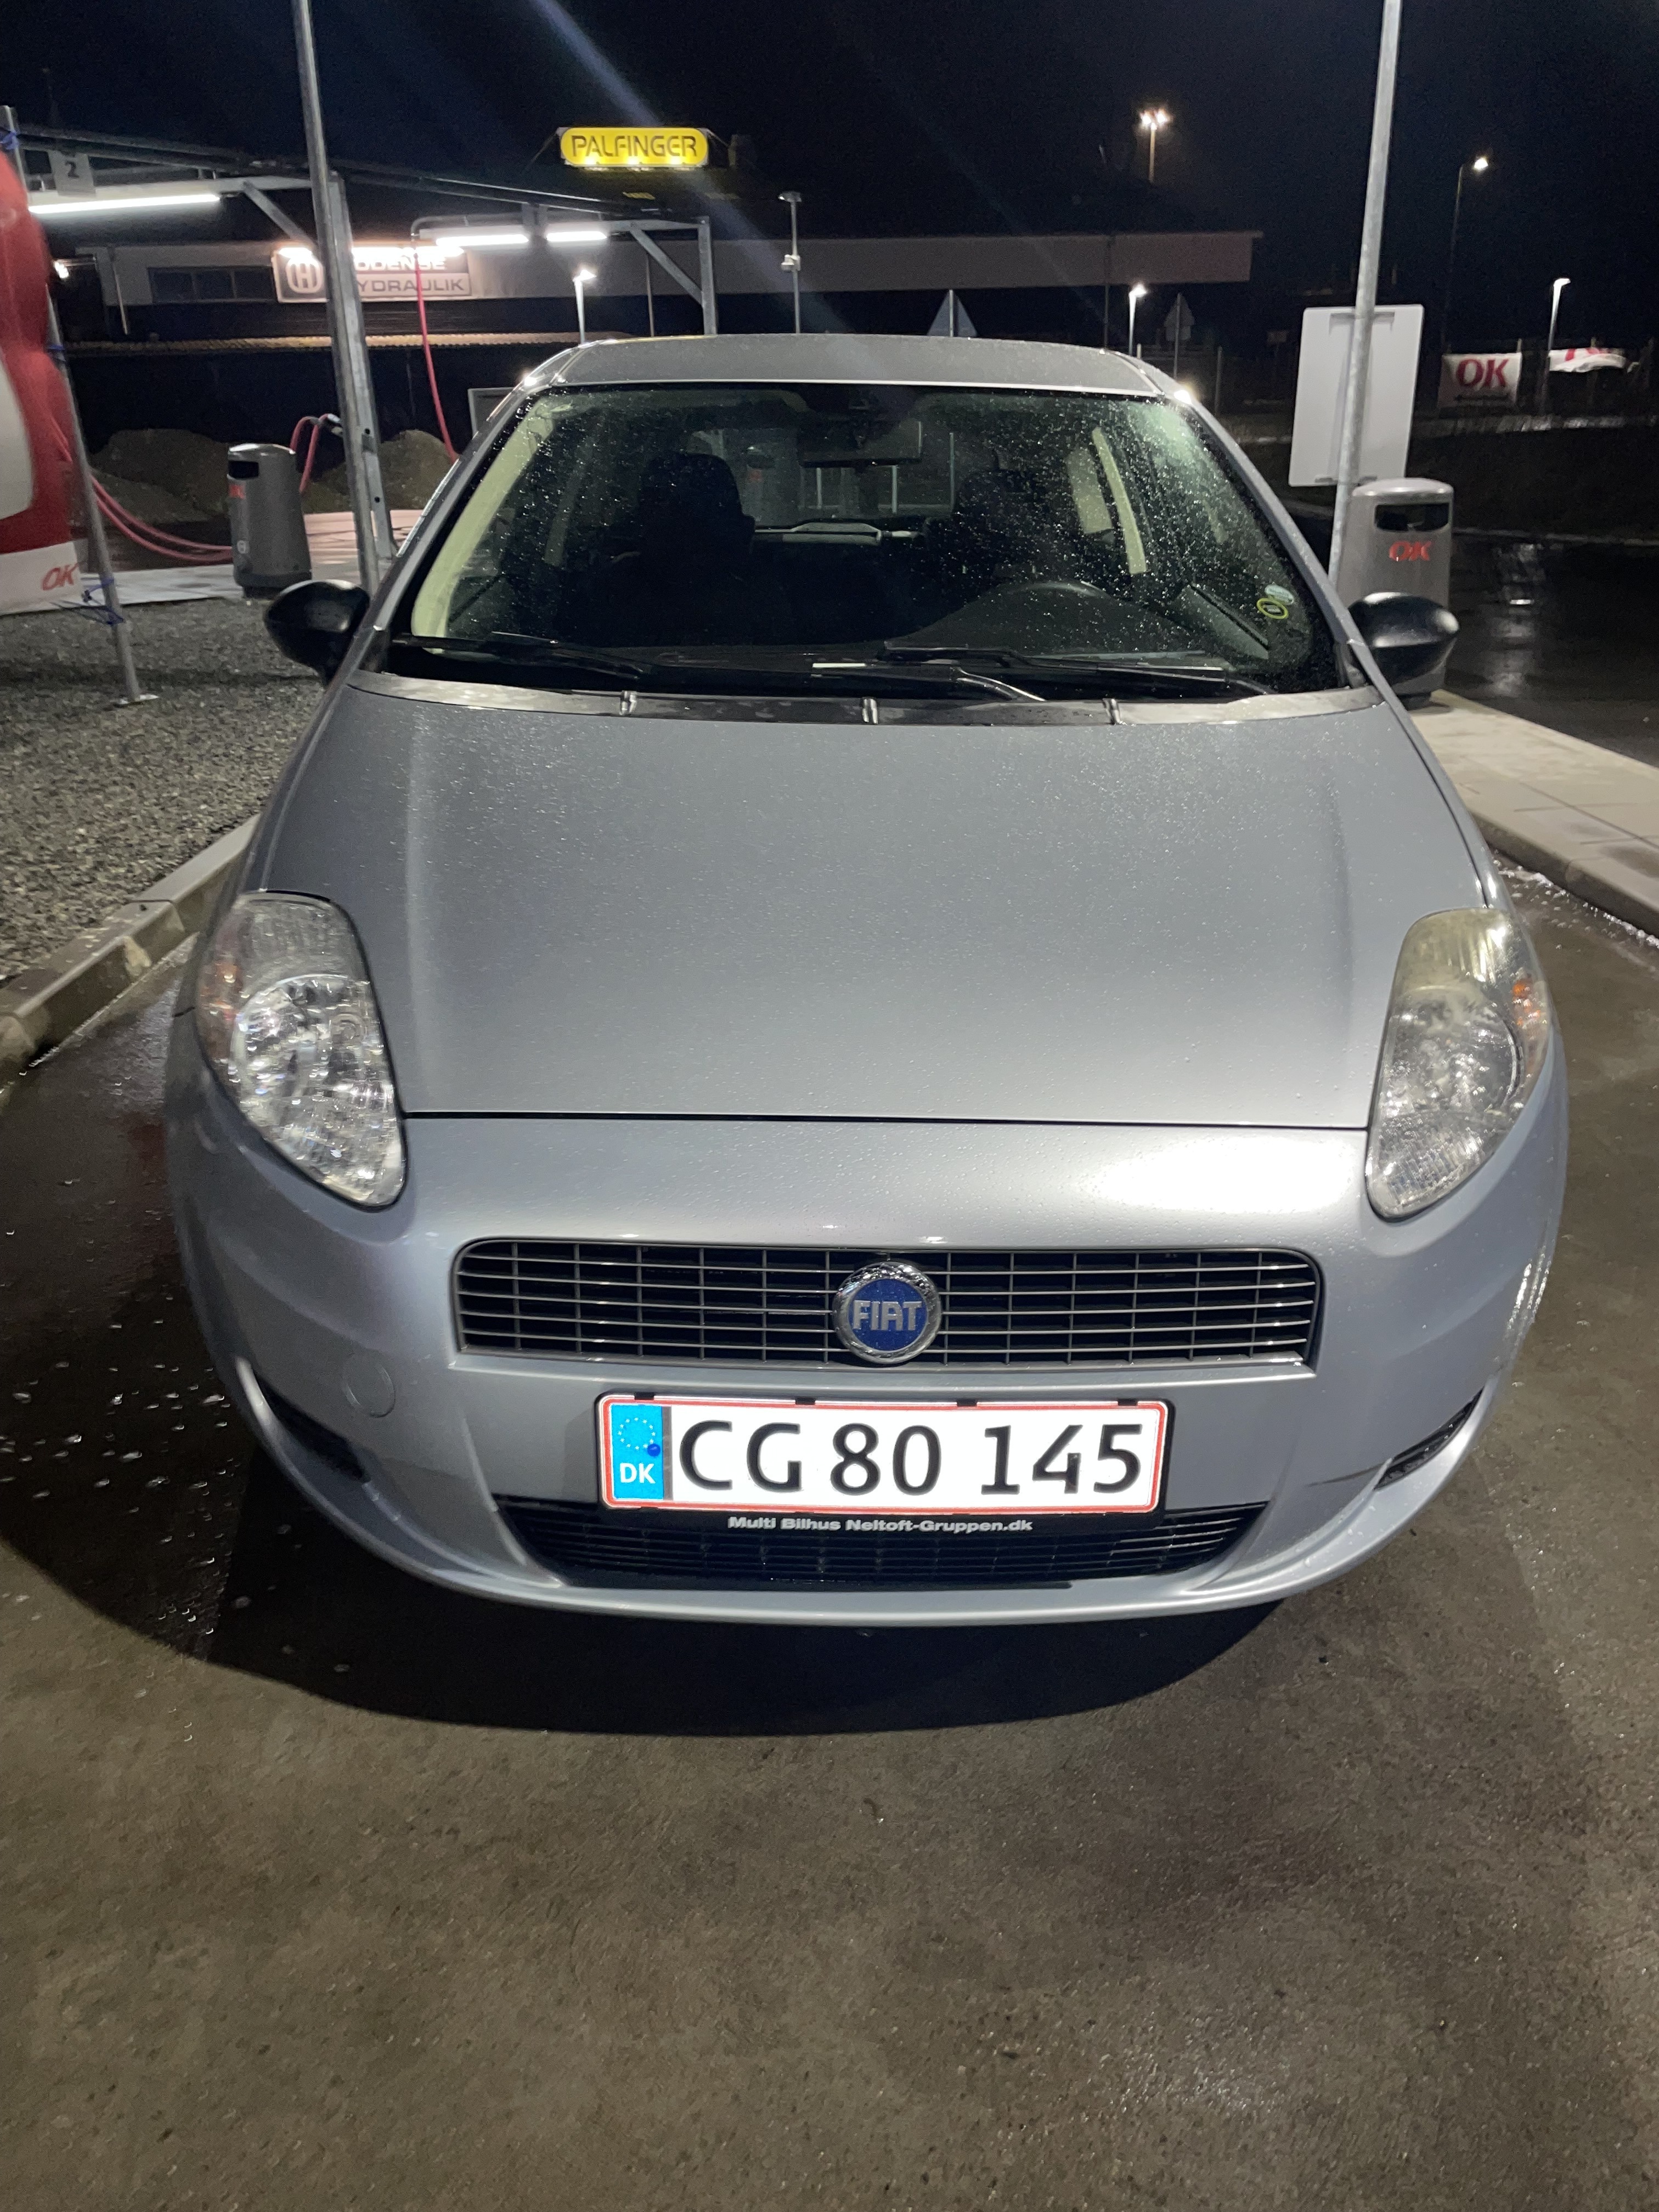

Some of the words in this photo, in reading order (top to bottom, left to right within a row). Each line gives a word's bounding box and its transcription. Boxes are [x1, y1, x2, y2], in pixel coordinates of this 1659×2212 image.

[571, 135, 697, 157] PALFINGER
[65, 160, 80, 178] 2
[357, 279, 465, 292] YDRAULIK
[1455, 359, 1509, 387] OK
[1389, 540, 1431, 562] OK
[42, 563, 79, 591] OK
[853, 1300, 922, 1331] FIAT
[679, 1420, 802, 1492] CG
[830, 1423, 942, 1496] 80
[981, 1424, 1143, 1495] 145
[619, 1463, 656, 1484] DK
[727, 1516, 776, 1529] Multi
[780, 1518, 841, 1531] Bilhus
[845, 1519, 1033, 1534] Neltoft-Gruppen.dk
